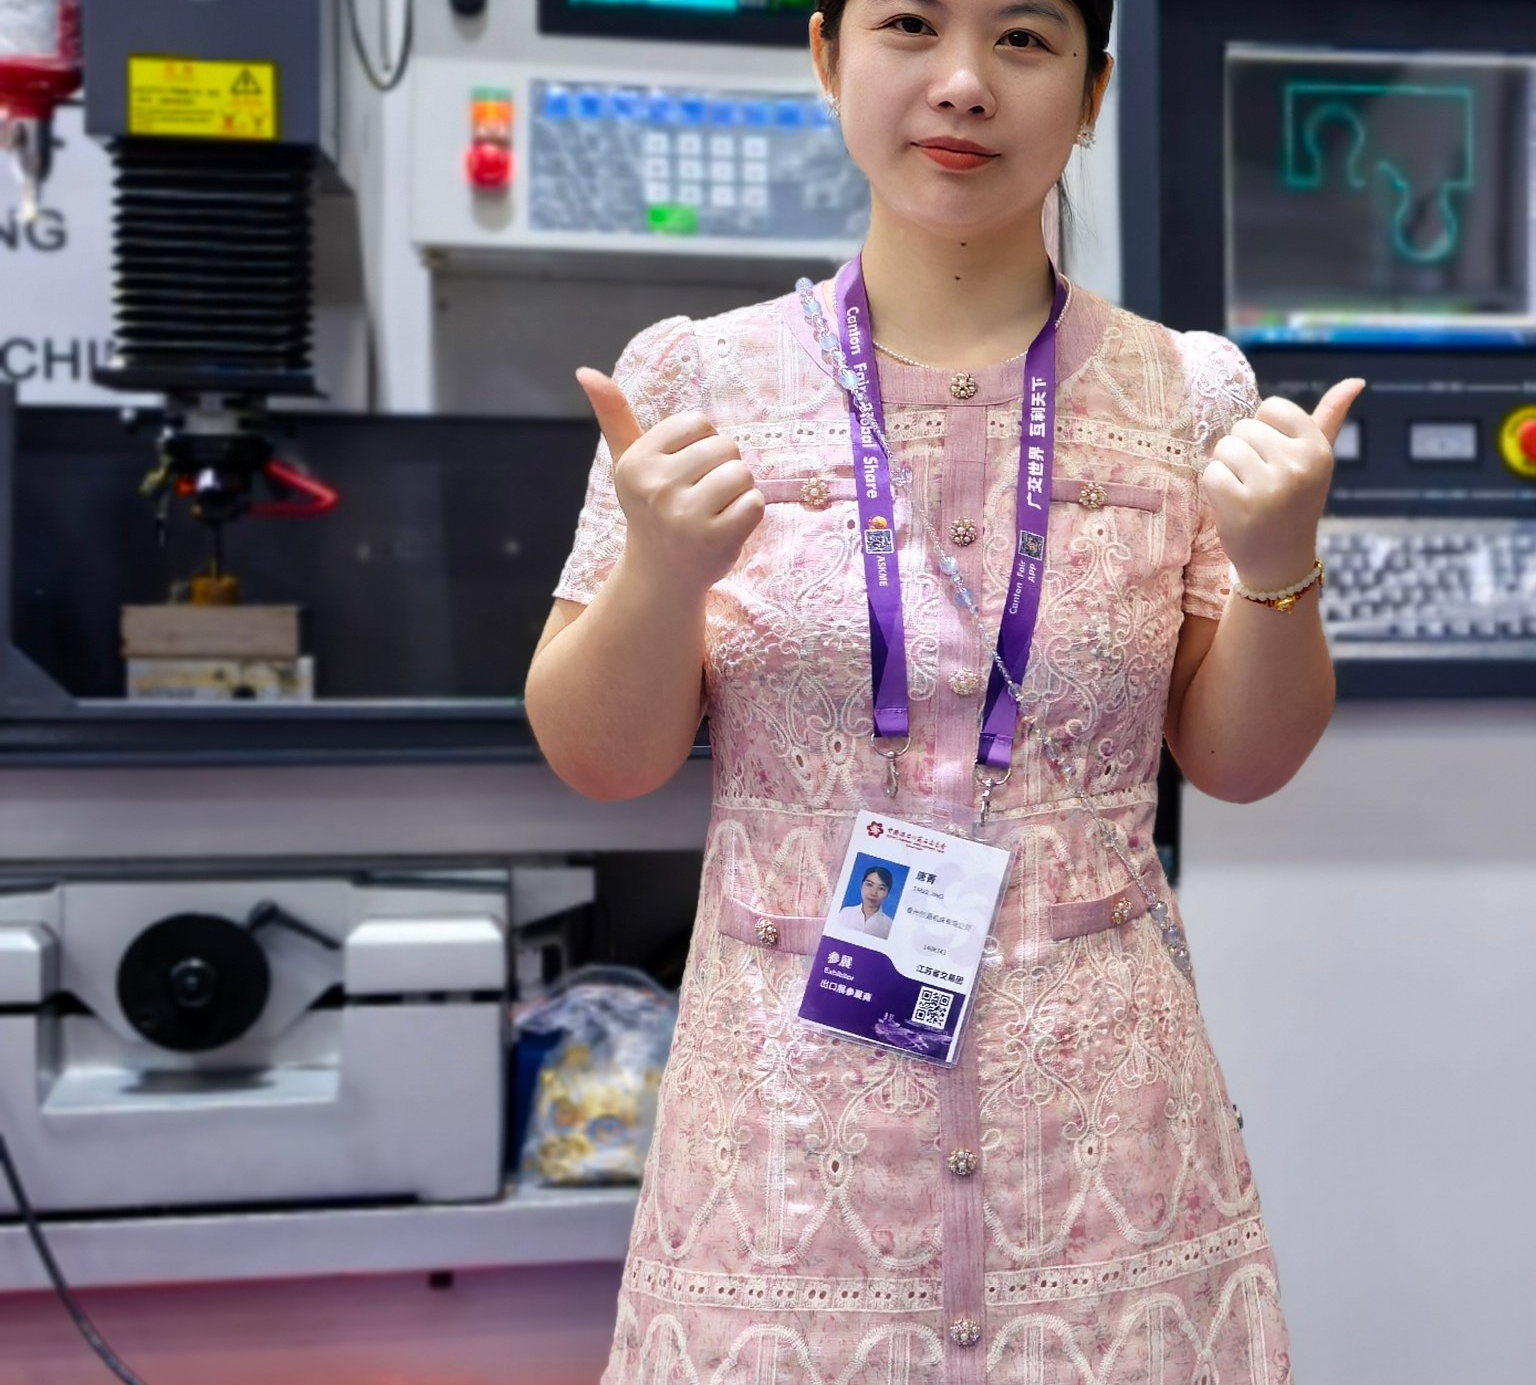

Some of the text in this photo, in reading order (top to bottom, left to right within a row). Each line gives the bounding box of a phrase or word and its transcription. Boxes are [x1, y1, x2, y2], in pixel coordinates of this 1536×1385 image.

[846, 306, 861, 356] Canton
[863, 456, 879, 499] Share
[1026, 376, 1046, 510] 广交世界 互利天下
[1009, 560, 1026, 614] Canton Fair
[1028, 563, 1037, 583] APP
